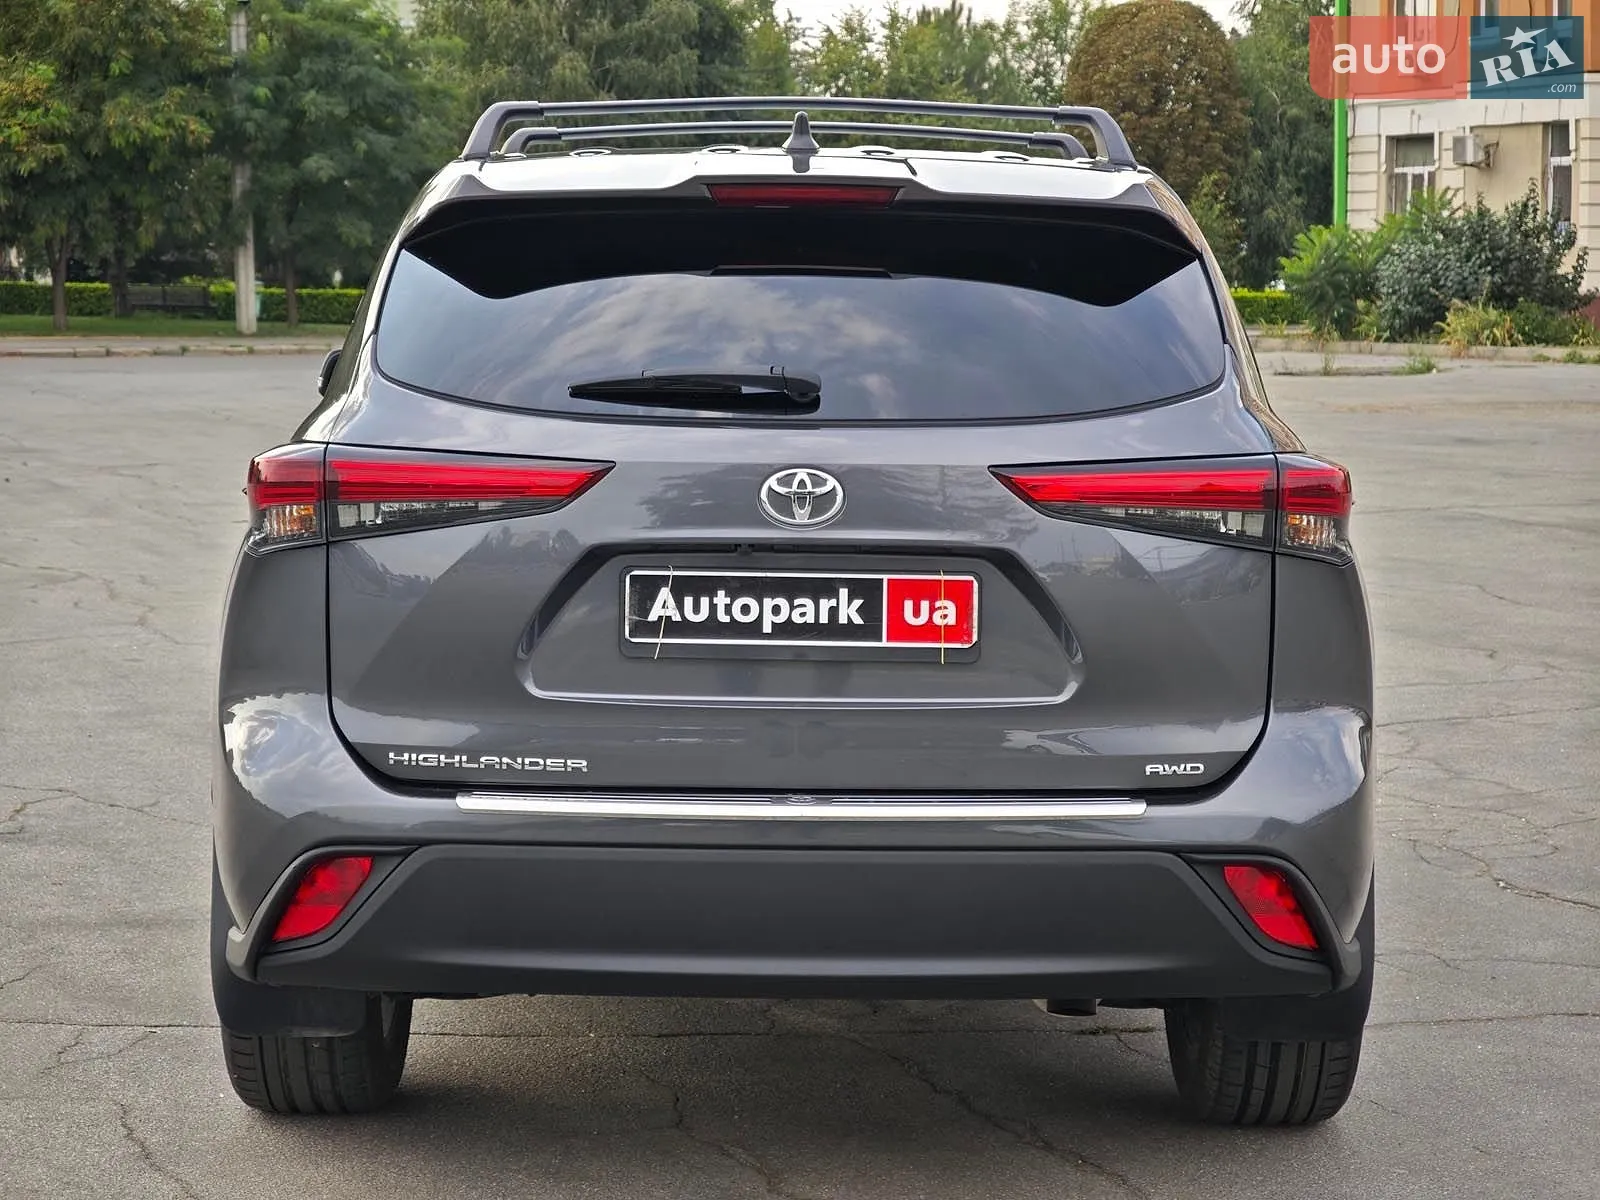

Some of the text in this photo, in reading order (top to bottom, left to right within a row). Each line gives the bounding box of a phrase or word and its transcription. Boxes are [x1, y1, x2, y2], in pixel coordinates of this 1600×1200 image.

[647, 587, 957, 633] Autopark ua
[388, 752, 588, 772] HIGHLANDER
[1145, 763, 1205, 776] AWD
